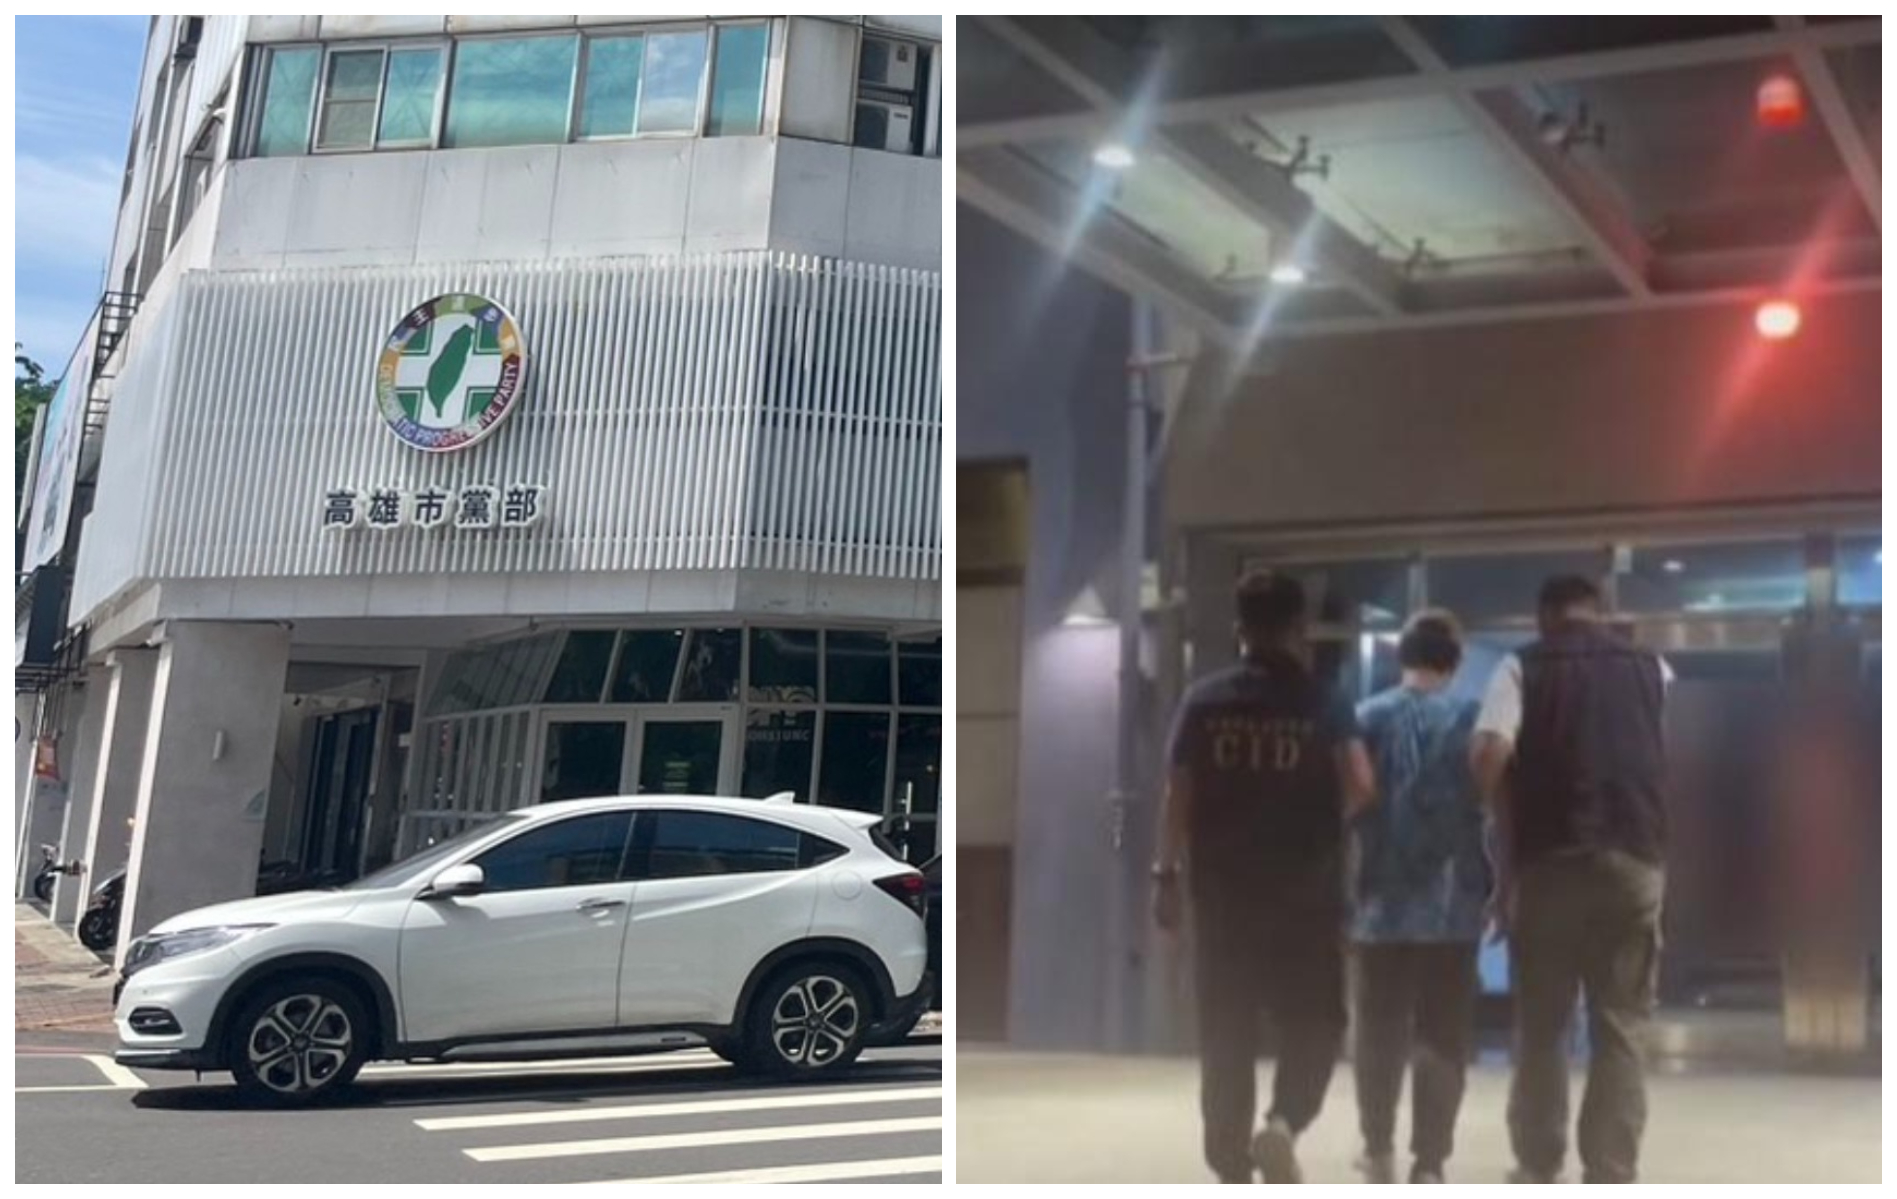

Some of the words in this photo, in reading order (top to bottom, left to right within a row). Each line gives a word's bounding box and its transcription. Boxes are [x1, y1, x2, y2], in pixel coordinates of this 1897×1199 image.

[497, 361, 518, 407] PARTY
[323, 487, 539, 525] 高雄市黨部
[1212, 734, 1300, 771] CID
